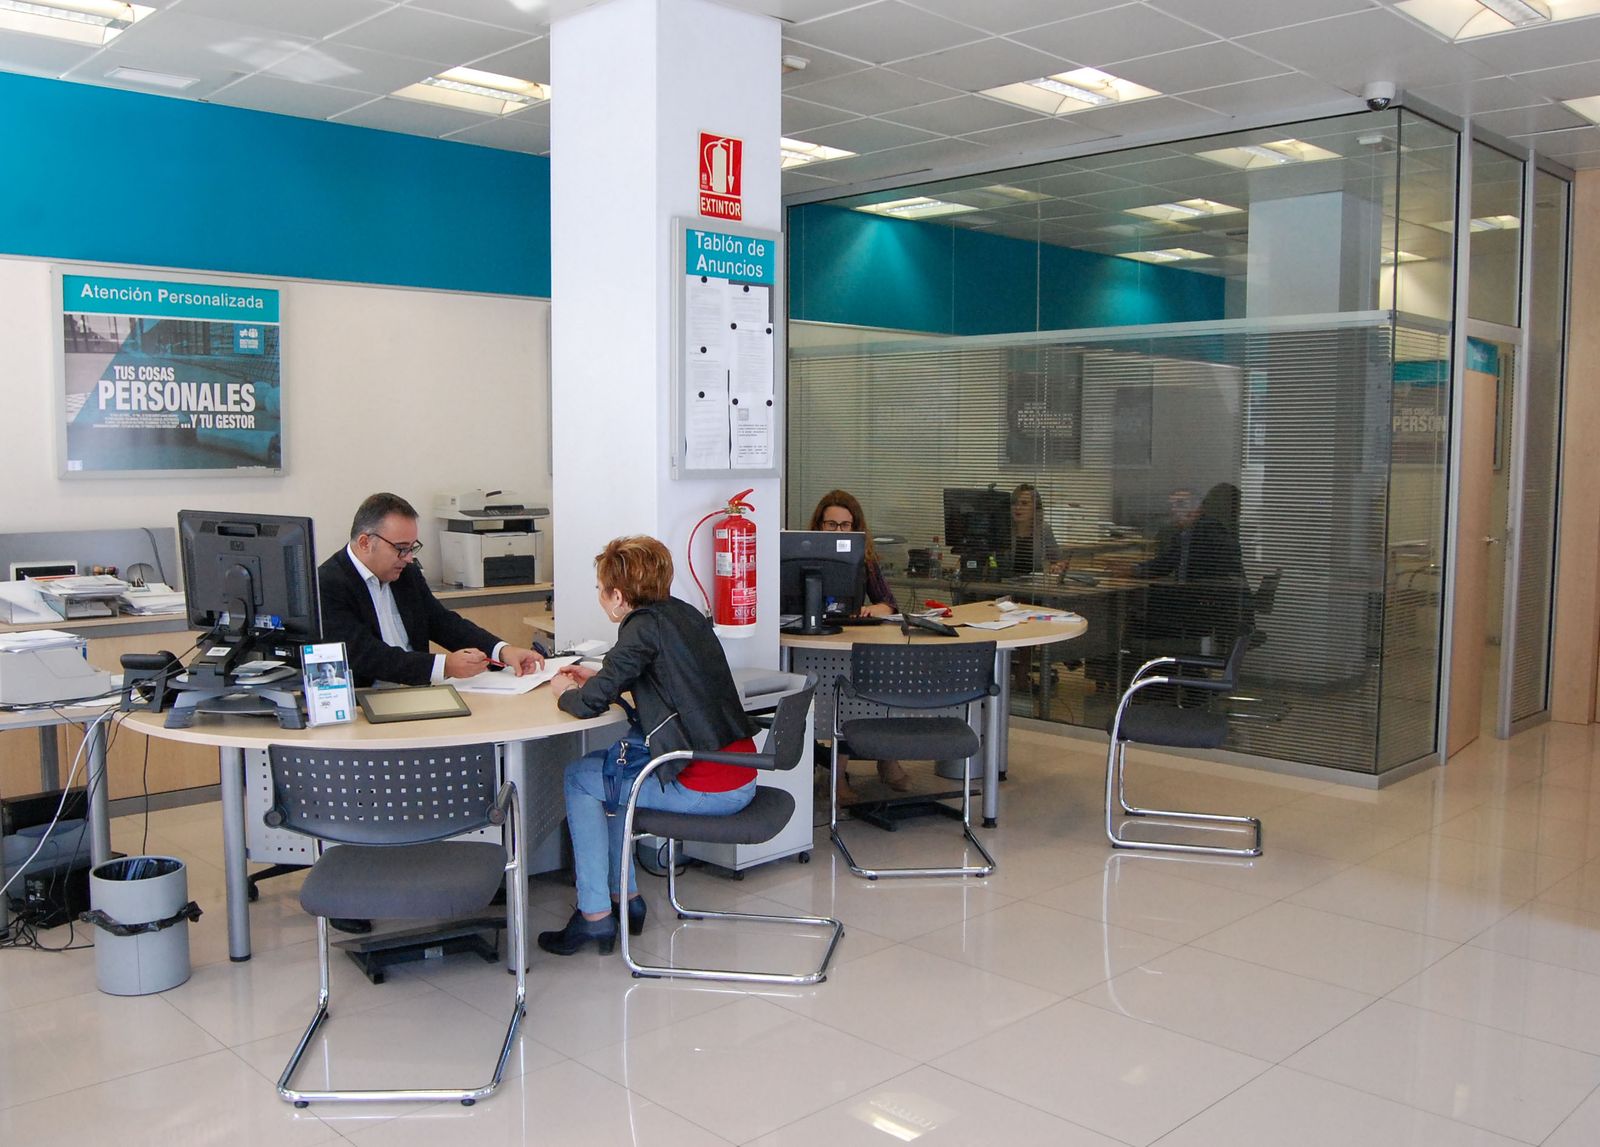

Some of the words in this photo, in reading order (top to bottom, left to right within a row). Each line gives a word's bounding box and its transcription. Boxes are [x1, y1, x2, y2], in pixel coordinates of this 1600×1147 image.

[701, 197, 740, 216] EXTINTOR
[695, 231, 742, 254] Tablón
[748, 240, 765, 256] de
[696, 254, 763, 277] Anuncios
[81, 283, 152, 302] Atención
[158, 289, 264, 309] Personalizada
[114, 366, 135, 380] TUS
[139, 366, 174, 381] COSAS
[98, 380, 255, 412] PERSONALES
[200, 415, 213, 428] TU
[216, 415, 255, 429] GESTOR
